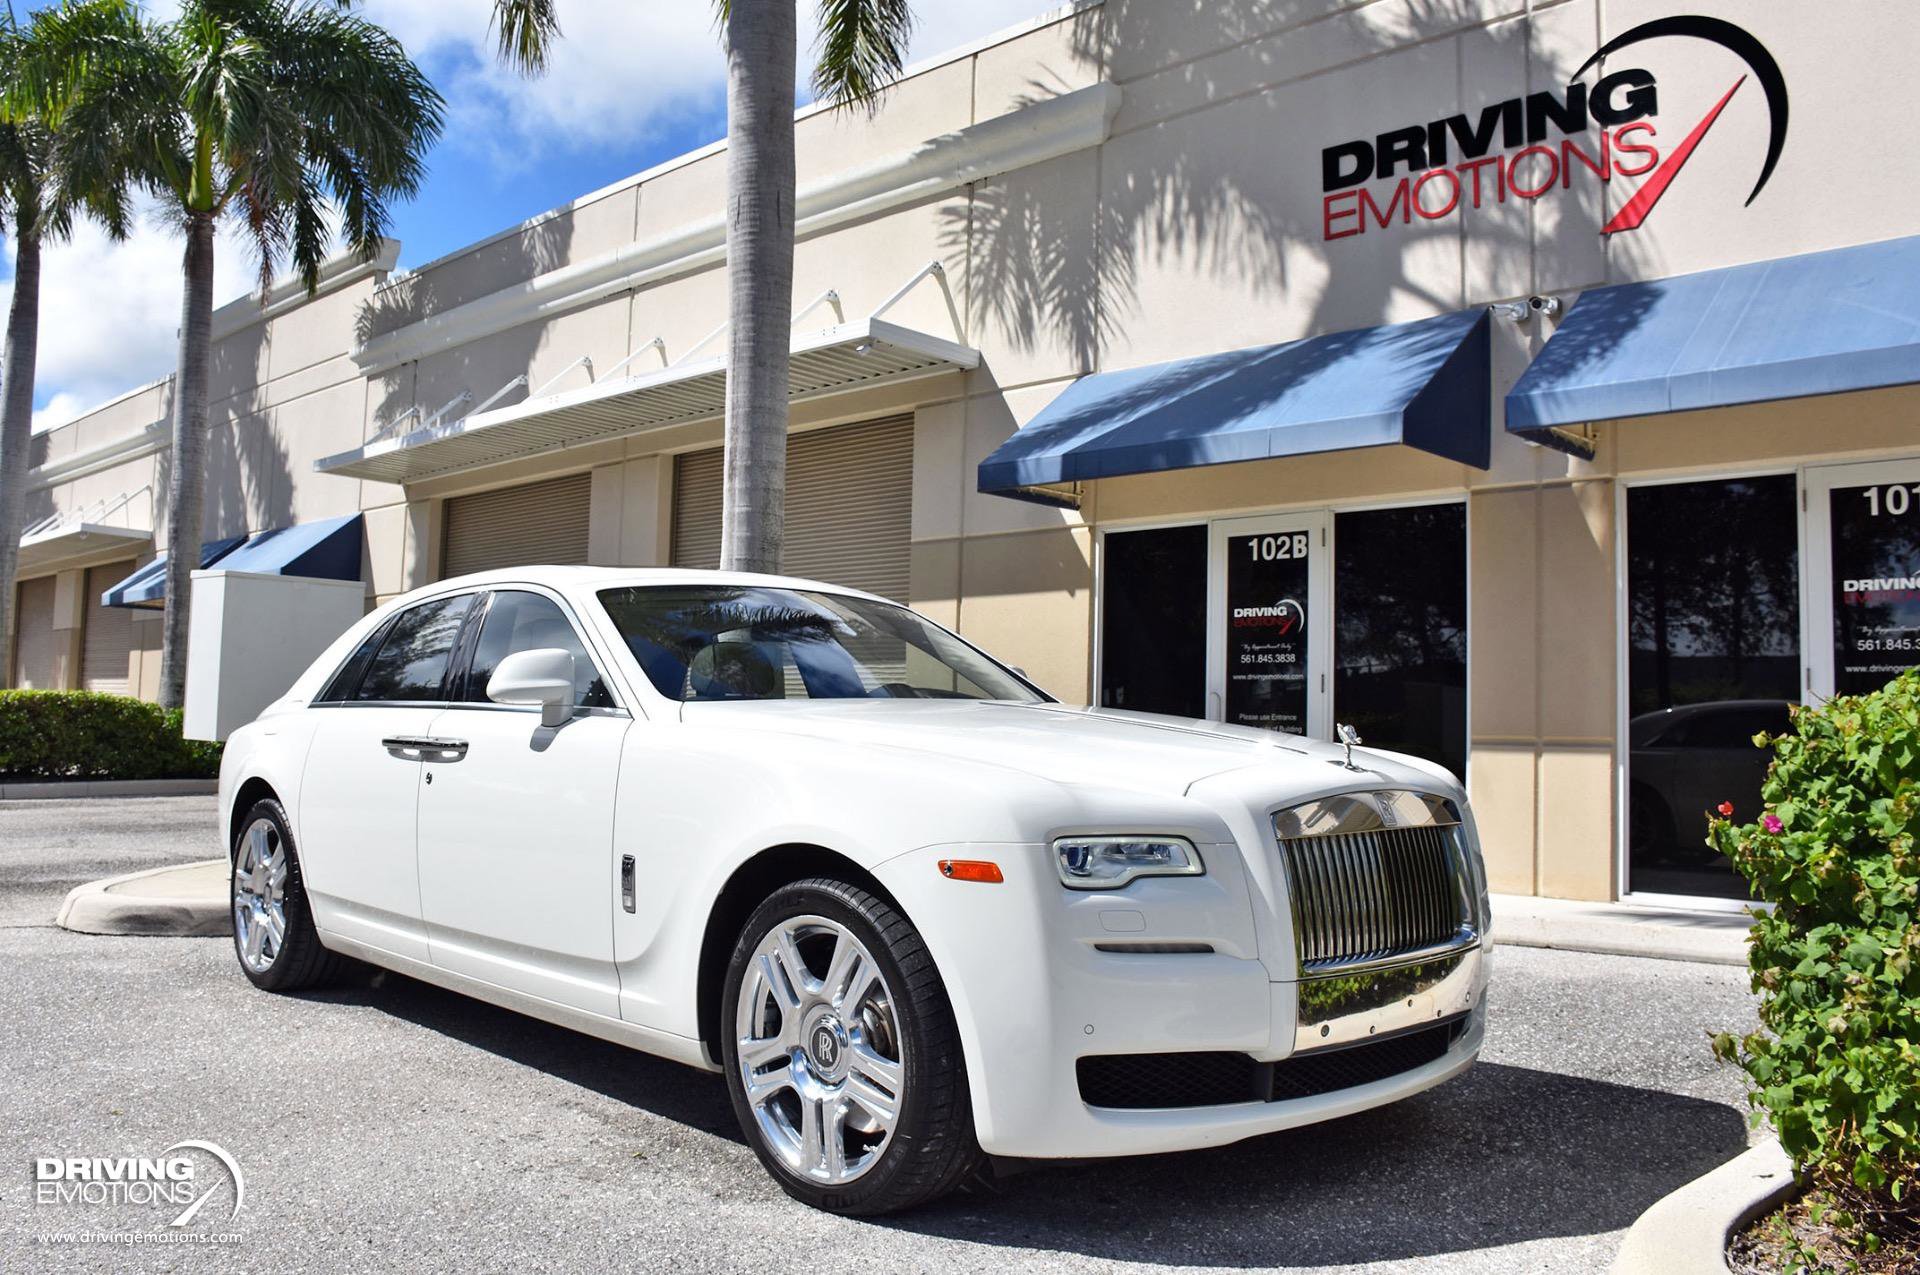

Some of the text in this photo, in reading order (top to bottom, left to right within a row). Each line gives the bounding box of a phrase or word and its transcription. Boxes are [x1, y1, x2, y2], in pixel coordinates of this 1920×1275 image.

[1322, 68, 1658, 192] DRIVING
[1323, 122, 1660, 241] EMOTIONS
[1248, 534, 1308, 561] 102B
[1233, 606, 1288, 618] DRIVING
[1240, 654, 1296, 664] 561.845.3838
